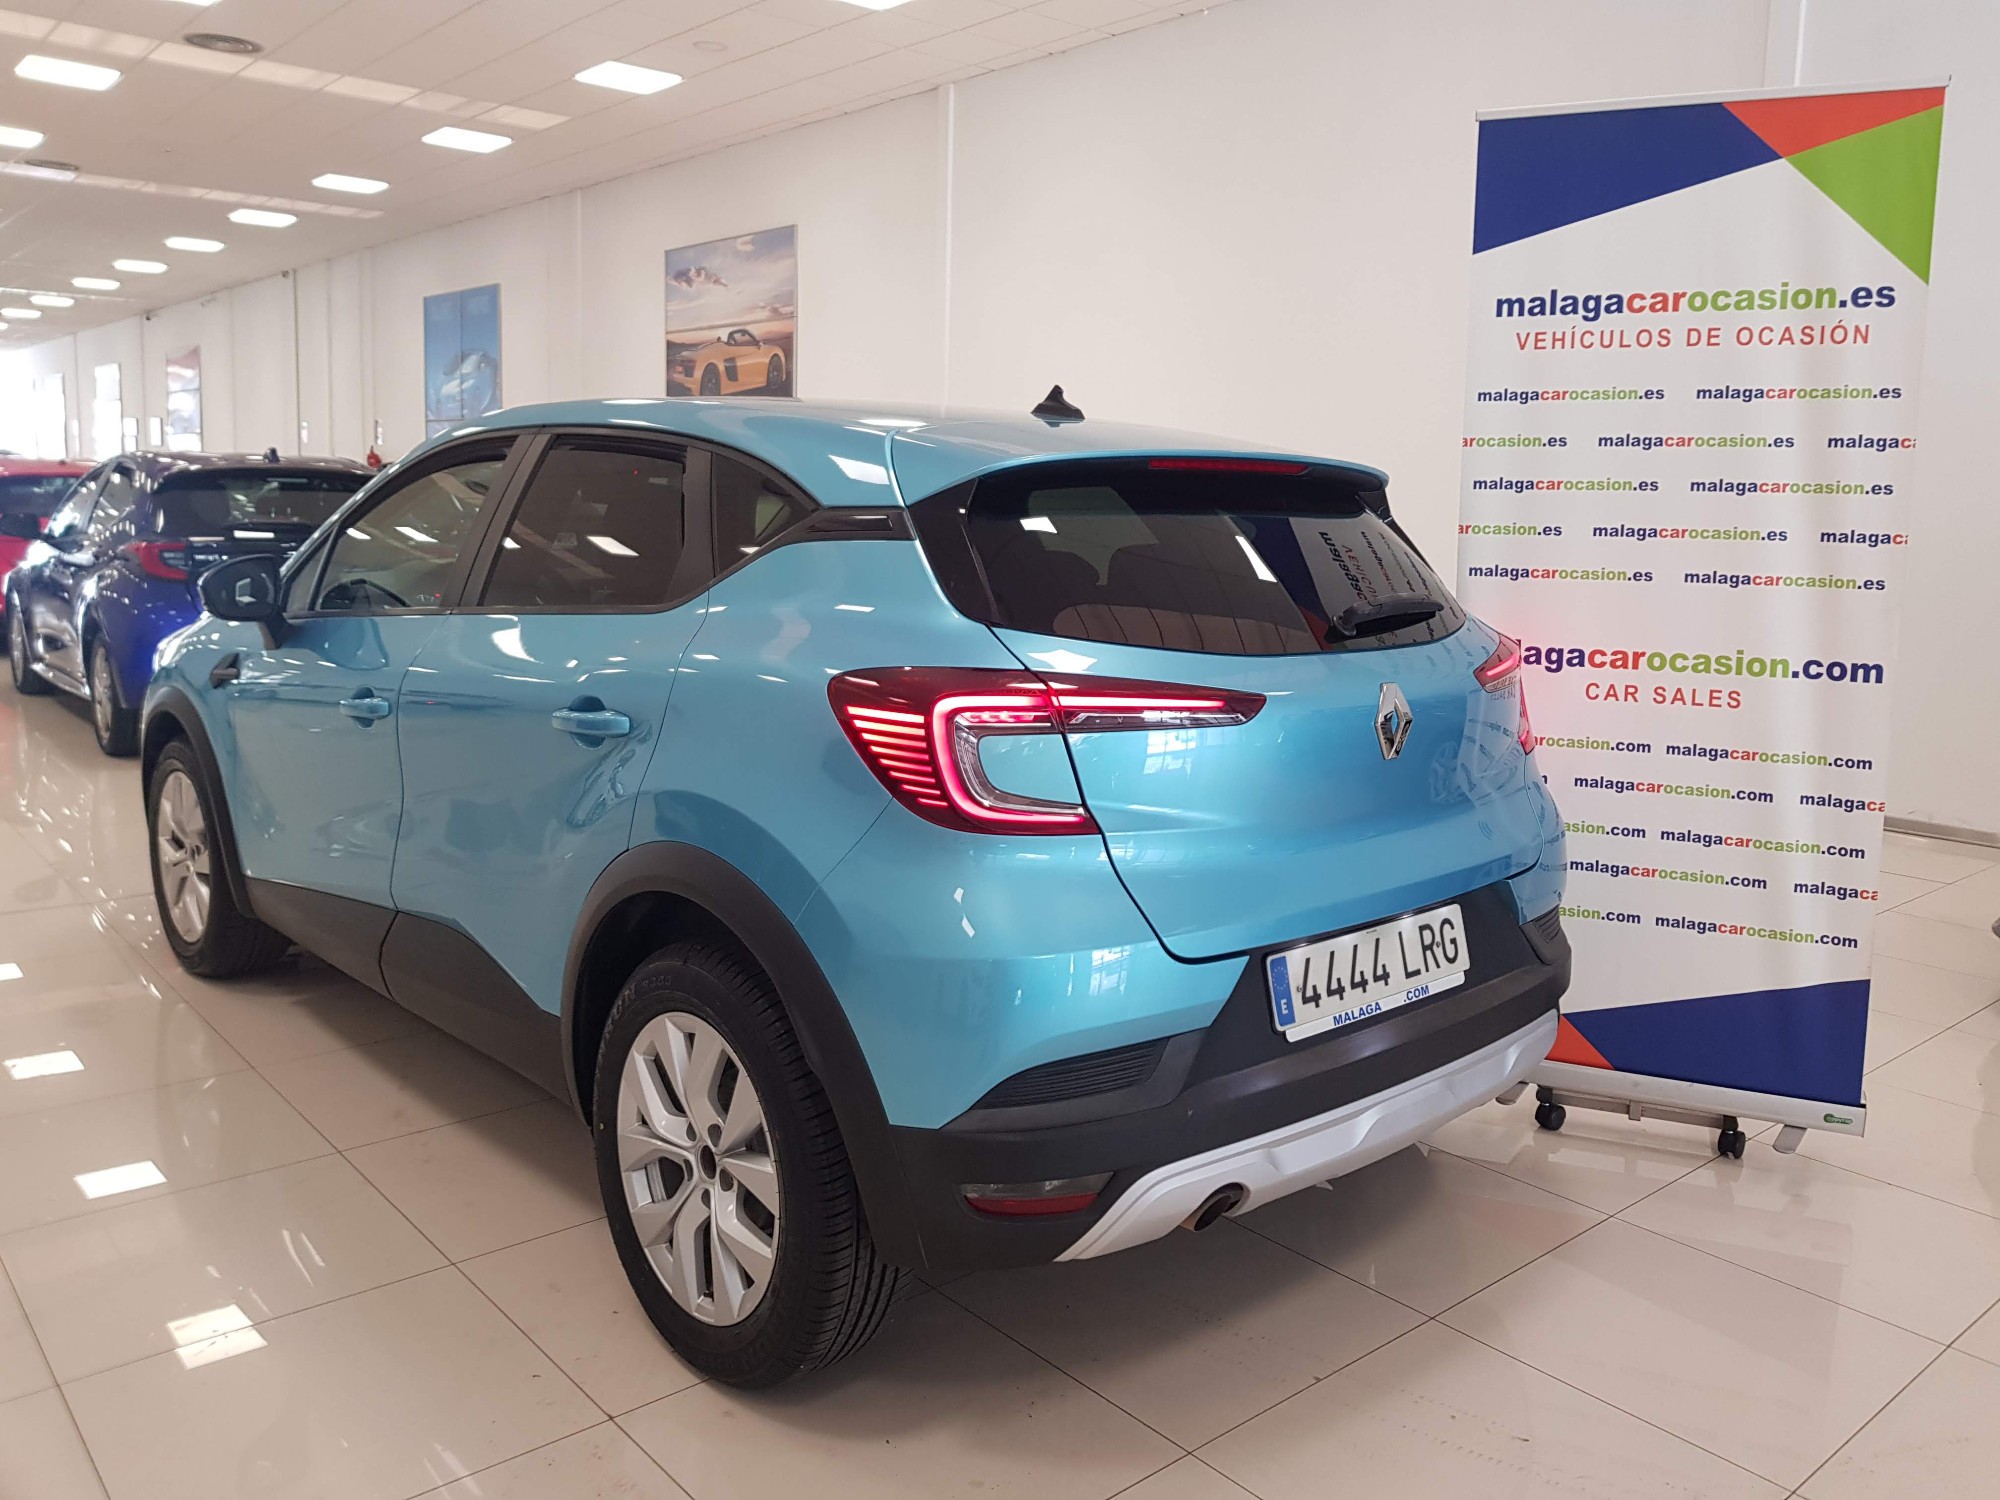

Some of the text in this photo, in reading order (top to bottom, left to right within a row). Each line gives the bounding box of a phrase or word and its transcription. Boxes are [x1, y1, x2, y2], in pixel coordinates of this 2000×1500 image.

[1496, 282, 1896, 322] malagacarocasion.es
[1516, 320, 1869, 350] VEHÍCULOS DE OCASIÓN
[1478, 385, 1902, 404] malagacarocasion.es malagacarocasion.es
[1598, 433, 1794, 450] malagacarocasion.es
[1473, 477, 1893, 496] malagacarocasion.es malagacarocasion.es
[1593, 524, 1787, 541] malagacarocasion.es
[1469, 564, 1885, 590] malagacarocasion.es malagacarocasion.es
[1586, 683, 1741, 709] CAR SALES
[1666, 744, 1872, 770] malagacarocasion.com
[1574, 776, 1773, 803] malagacarocasion.com
[1661, 830, 1865, 859] malagacarocasion.com
[1570, 860, 1767, 889] malagacarocasion.com
[1656, 916, 1857, 948] malagacarocasion.com
[1280, 917, 1460, 1015] E 4444 LRG
[1333, 984, 1430, 1027] MALAGA .COM
